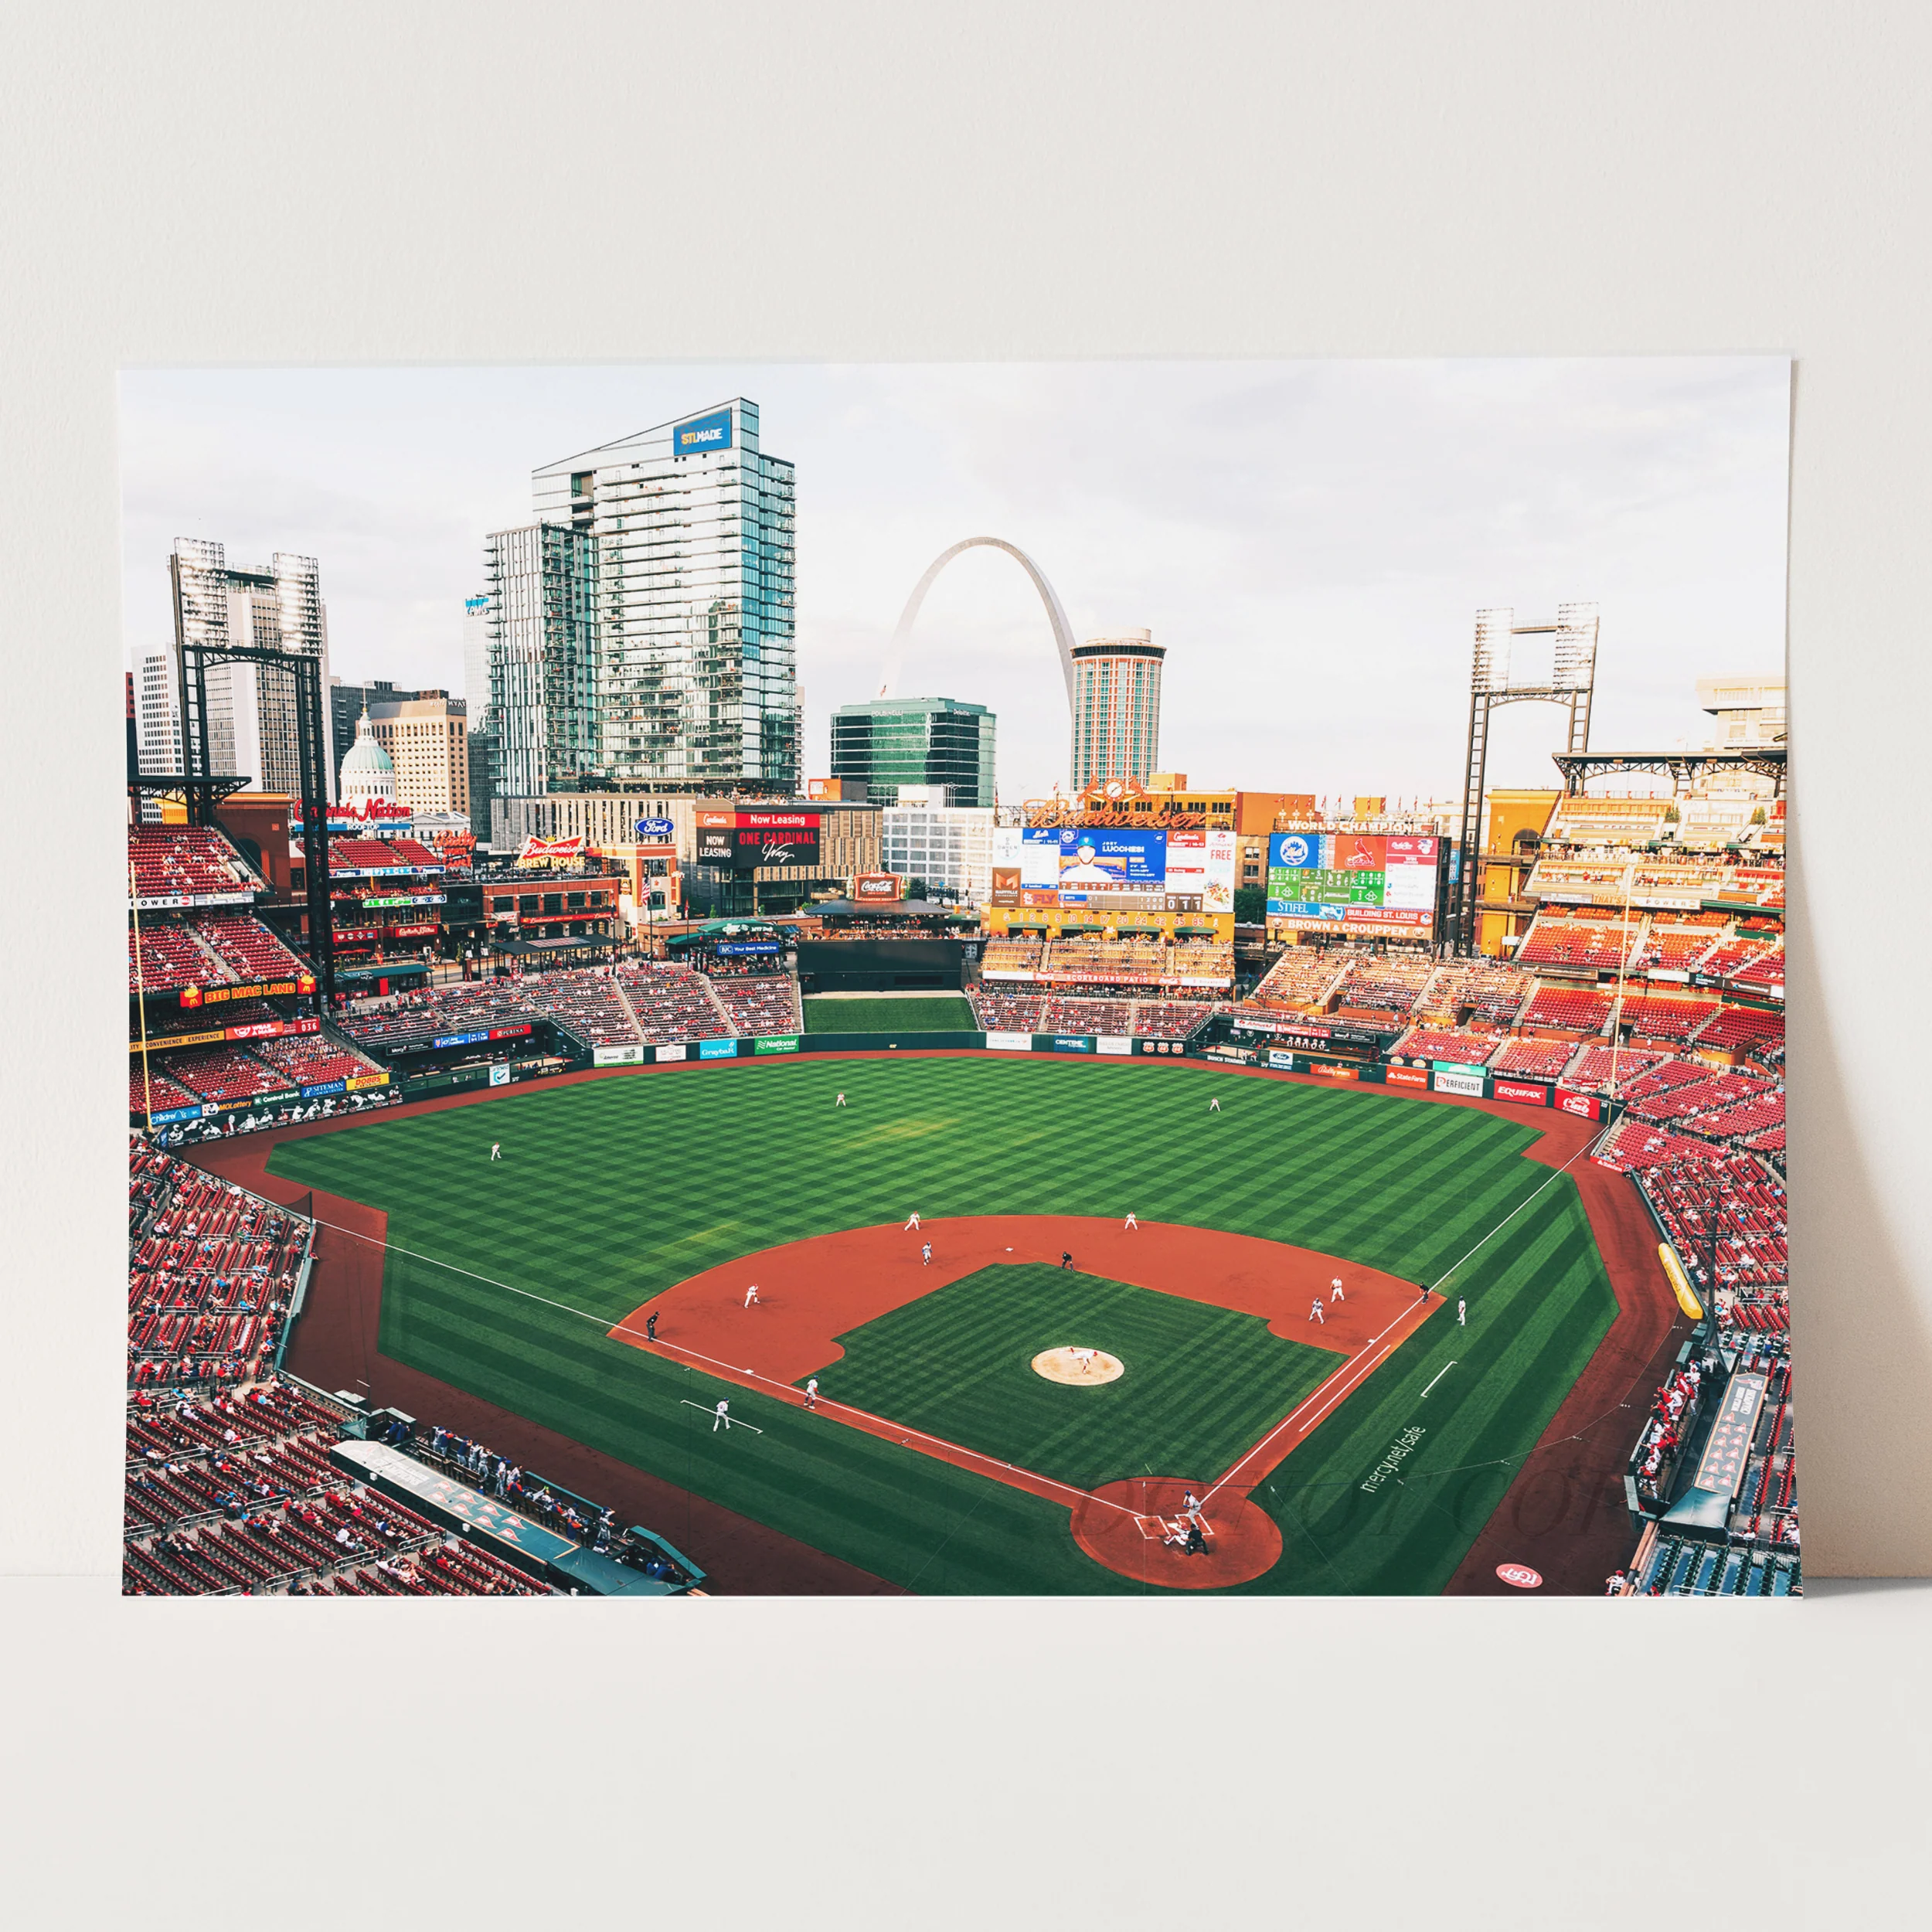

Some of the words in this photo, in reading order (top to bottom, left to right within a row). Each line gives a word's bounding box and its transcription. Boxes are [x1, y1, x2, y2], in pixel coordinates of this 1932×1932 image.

[359, 798, 411, 823] Nation
[1022, 798, 1207, 829] Budweiser
[644, 819, 668, 833] Ford
[750, 815, 770, 825] Now
[772, 815, 805, 826] Leasing
[1287, 819, 1336, 832] WORLD
[1339, 821, 1423, 833] CHAMPIONS
[706, 836, 725, 845] NOW
[739, 832, 760, 845] ONE
[764, 832, 816, 845] CARDINAL
[519, 842, 585, 856] Budweiser
[699, 848, 732, 858] LEASING
[762, 839, 795, 863] Way
[1210, 849, 1232, 861] FREE
[518, 857, 549, 869] BREW
[551, 855, 586, 867] HOUSE
[1033, 894, 1056, 904] FLY
[1168, 900, 1175, 910] 0
[1182, 900, 1188, 910] 1
[1195, 900, 1201, 910] 1
[1594, 894, 1621, 904] THAT'S
[1277, 900, 1309, 913] STIFEL
[1029, 913, 1036, 923] 2
[1043, 913, 1049, 923] 6
[1055, 914, 1062, 923] 9
[1068, 913, 1077, 923] 10
[1084, 914, 1094, 923] 14
[1100, 914, 1110, 924] 17
[1117, 915, 1128, 925] 20
[1135, 916, 1148, 925] 24
[1155, 916, 1166, 927] 42
[1173, 916, 1185, 927] 45
[1192, 917, 1205, 927] 85
[1347, 909, 1383, 918] BUILDING
[1396, 911, 1419, 920] LOUIS
[1287, 919, 1331, 931] BROWN
[1342, 922, 1409, 936] CROUPPEN
[1066, 974, 1121, 982] SCOREBOARD
[204, 988, 230, 1004] BIG
[231, 985, 263, 1000] MAC
[264, 982, 296, 996] LAND
[145, 1038, 183, 1049] CONVENIENCE
[188, 1032, 220, 1043] EXPERIENCE
[765, 1039, 798, 1049] National
[313, 1082, 344, 1092] SITEMAN
[355, 1076, 381, 1086] DOBBS
[263, 1094, 284, 1104] Central
[284, 1090, 300, 1099] Bank
[1498, 1086, 1542, 1099] EQUIFAX
[1360, 1426, 1427, 1493] mercy.net/safe
